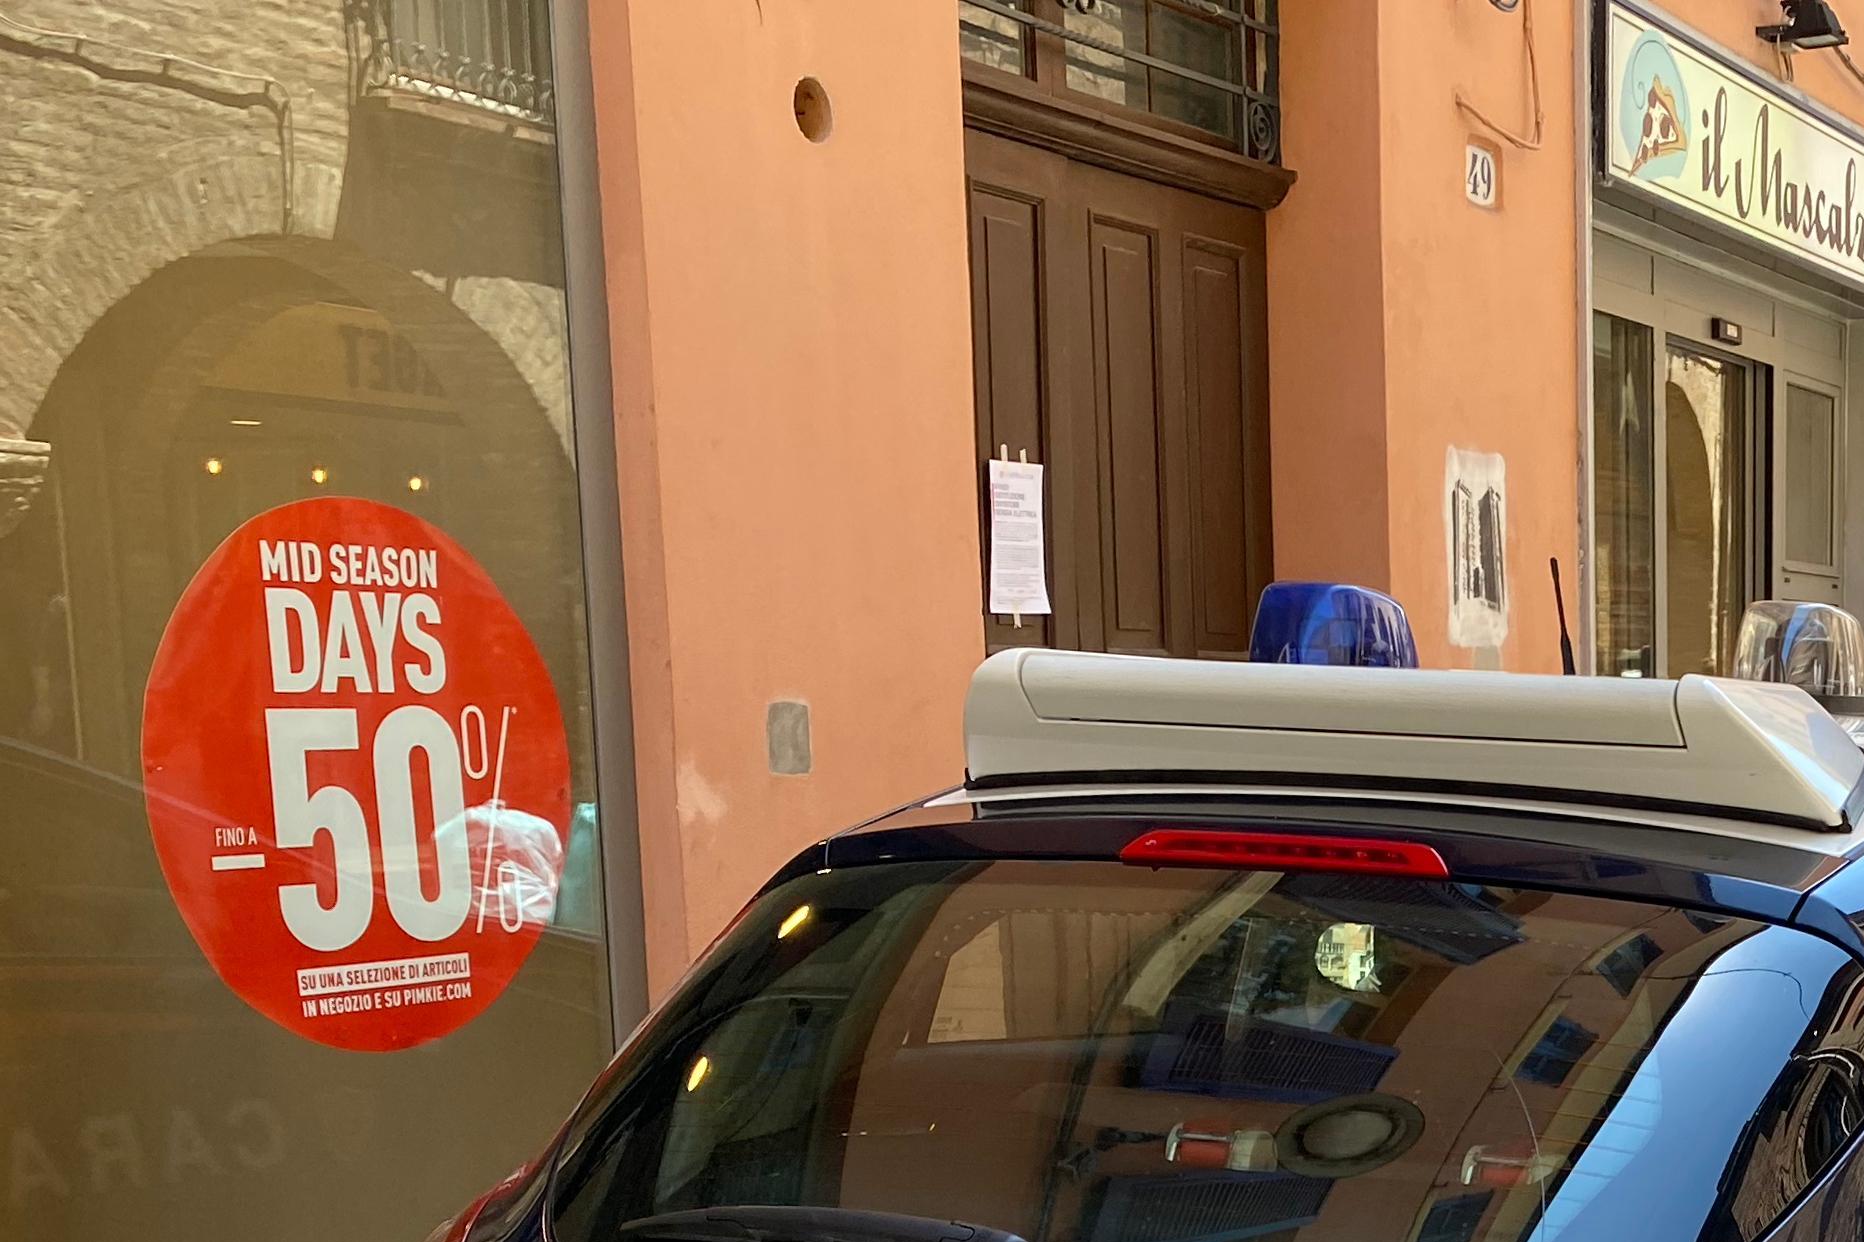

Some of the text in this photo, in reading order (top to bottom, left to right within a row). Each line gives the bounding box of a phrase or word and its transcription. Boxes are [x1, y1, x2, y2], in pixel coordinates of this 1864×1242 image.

[1701, 86, 1730, 198] il
[1467, 151, 1492, 200] 49
[259, 539, 438, 588] MID SEASON
[264, 587, 447, 694] DAYS
[215, 827, 258, 848] FINO A
[300, 957, 468, 991] SU UNA SELEZIONE DI ARTICOLI
[302, 982, 473, 1018] IN NEGOZIO E SU PIMKIE.COM
